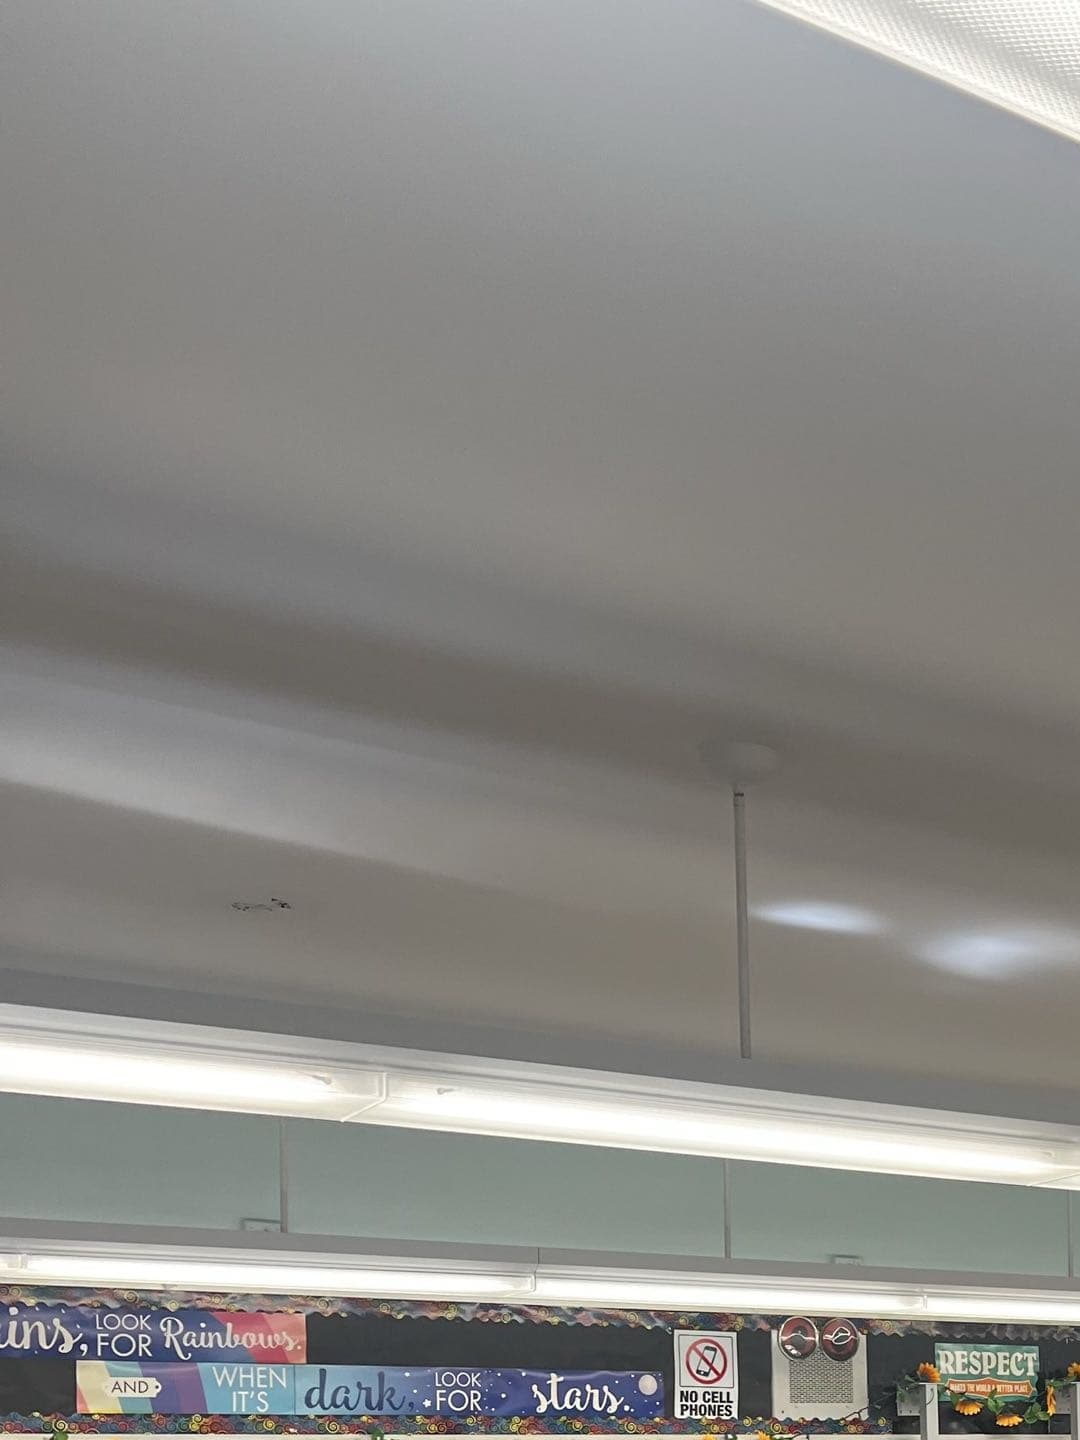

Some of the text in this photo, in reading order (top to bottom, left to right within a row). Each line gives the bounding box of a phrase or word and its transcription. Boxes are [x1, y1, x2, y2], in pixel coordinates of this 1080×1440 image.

[96, 1313, 152, 1330] LOOK
[96, 1333, 153, 1357] FOR
[160, 1316, 303, 1360] Rainbows.
[938, 1350, 1037, 1376] RESPECT
[111, 1381, 149, 1394] AND
[212, 1366, 287, 1389] WHEN
[435, 1372, 482, 1388] LOOK
[232, 1391, 269, 1412] IT'S
[435, 1390, 482, 1412] FOR
[680, 1390, 734, 1403] NO CELL
[680, 1404, 733, 1417] PHONES
